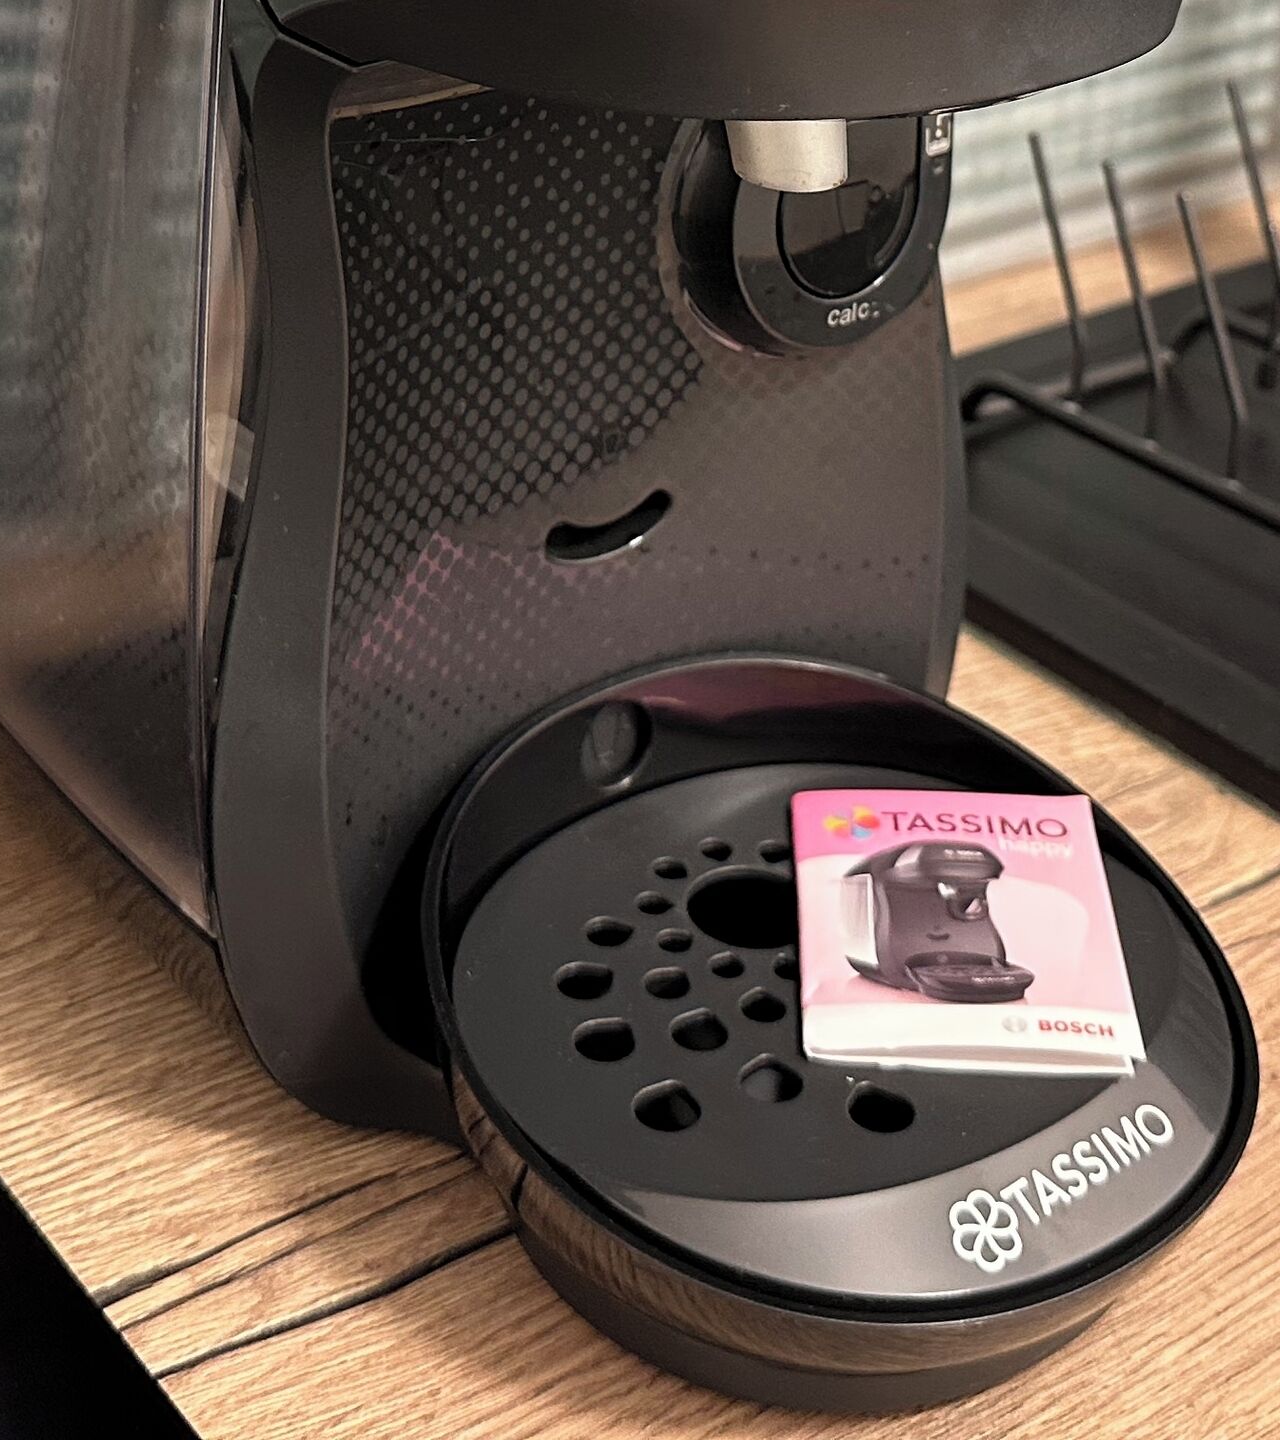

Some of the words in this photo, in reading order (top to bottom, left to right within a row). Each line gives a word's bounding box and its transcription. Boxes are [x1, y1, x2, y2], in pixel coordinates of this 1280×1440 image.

[881, 810, 1068, 838] TASSIMO
[1038, 1019, 1114, 1038] BOSCH
[1000, 1104, 1175, 1225] TASSIMO
